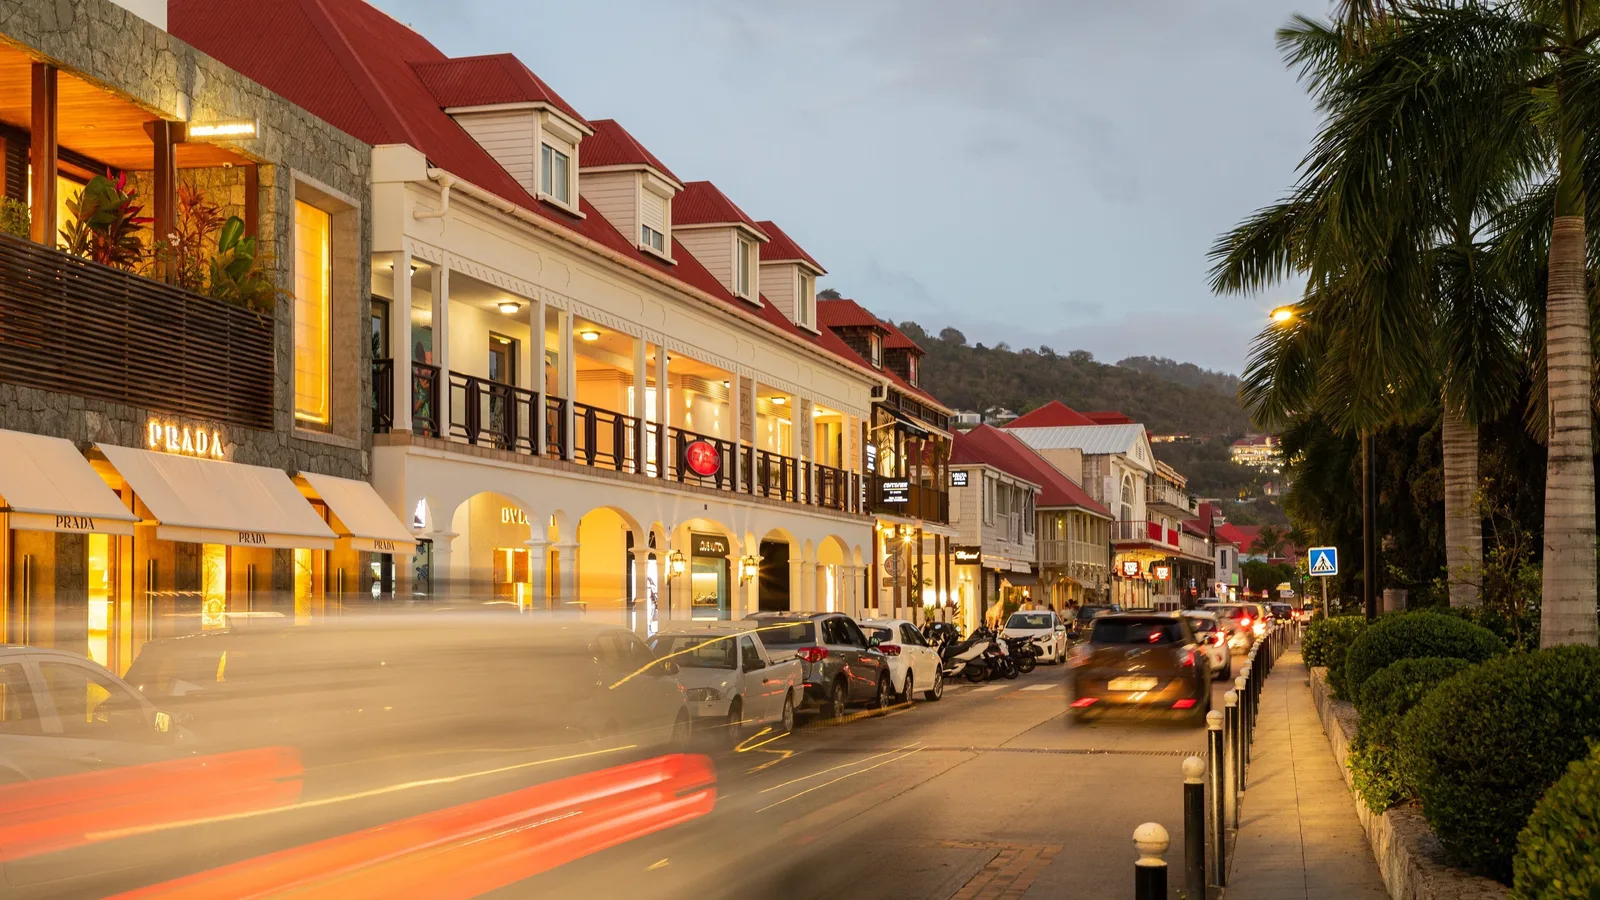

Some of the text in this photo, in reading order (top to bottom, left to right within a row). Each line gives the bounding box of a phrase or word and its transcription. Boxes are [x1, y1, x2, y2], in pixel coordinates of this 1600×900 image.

[148, 421, 224, 456] PRADA
[56, 515, 95, 530] PRADA
[239, 531, 267, 544] PRADA
[374, 540, 395, 551] PRADA
